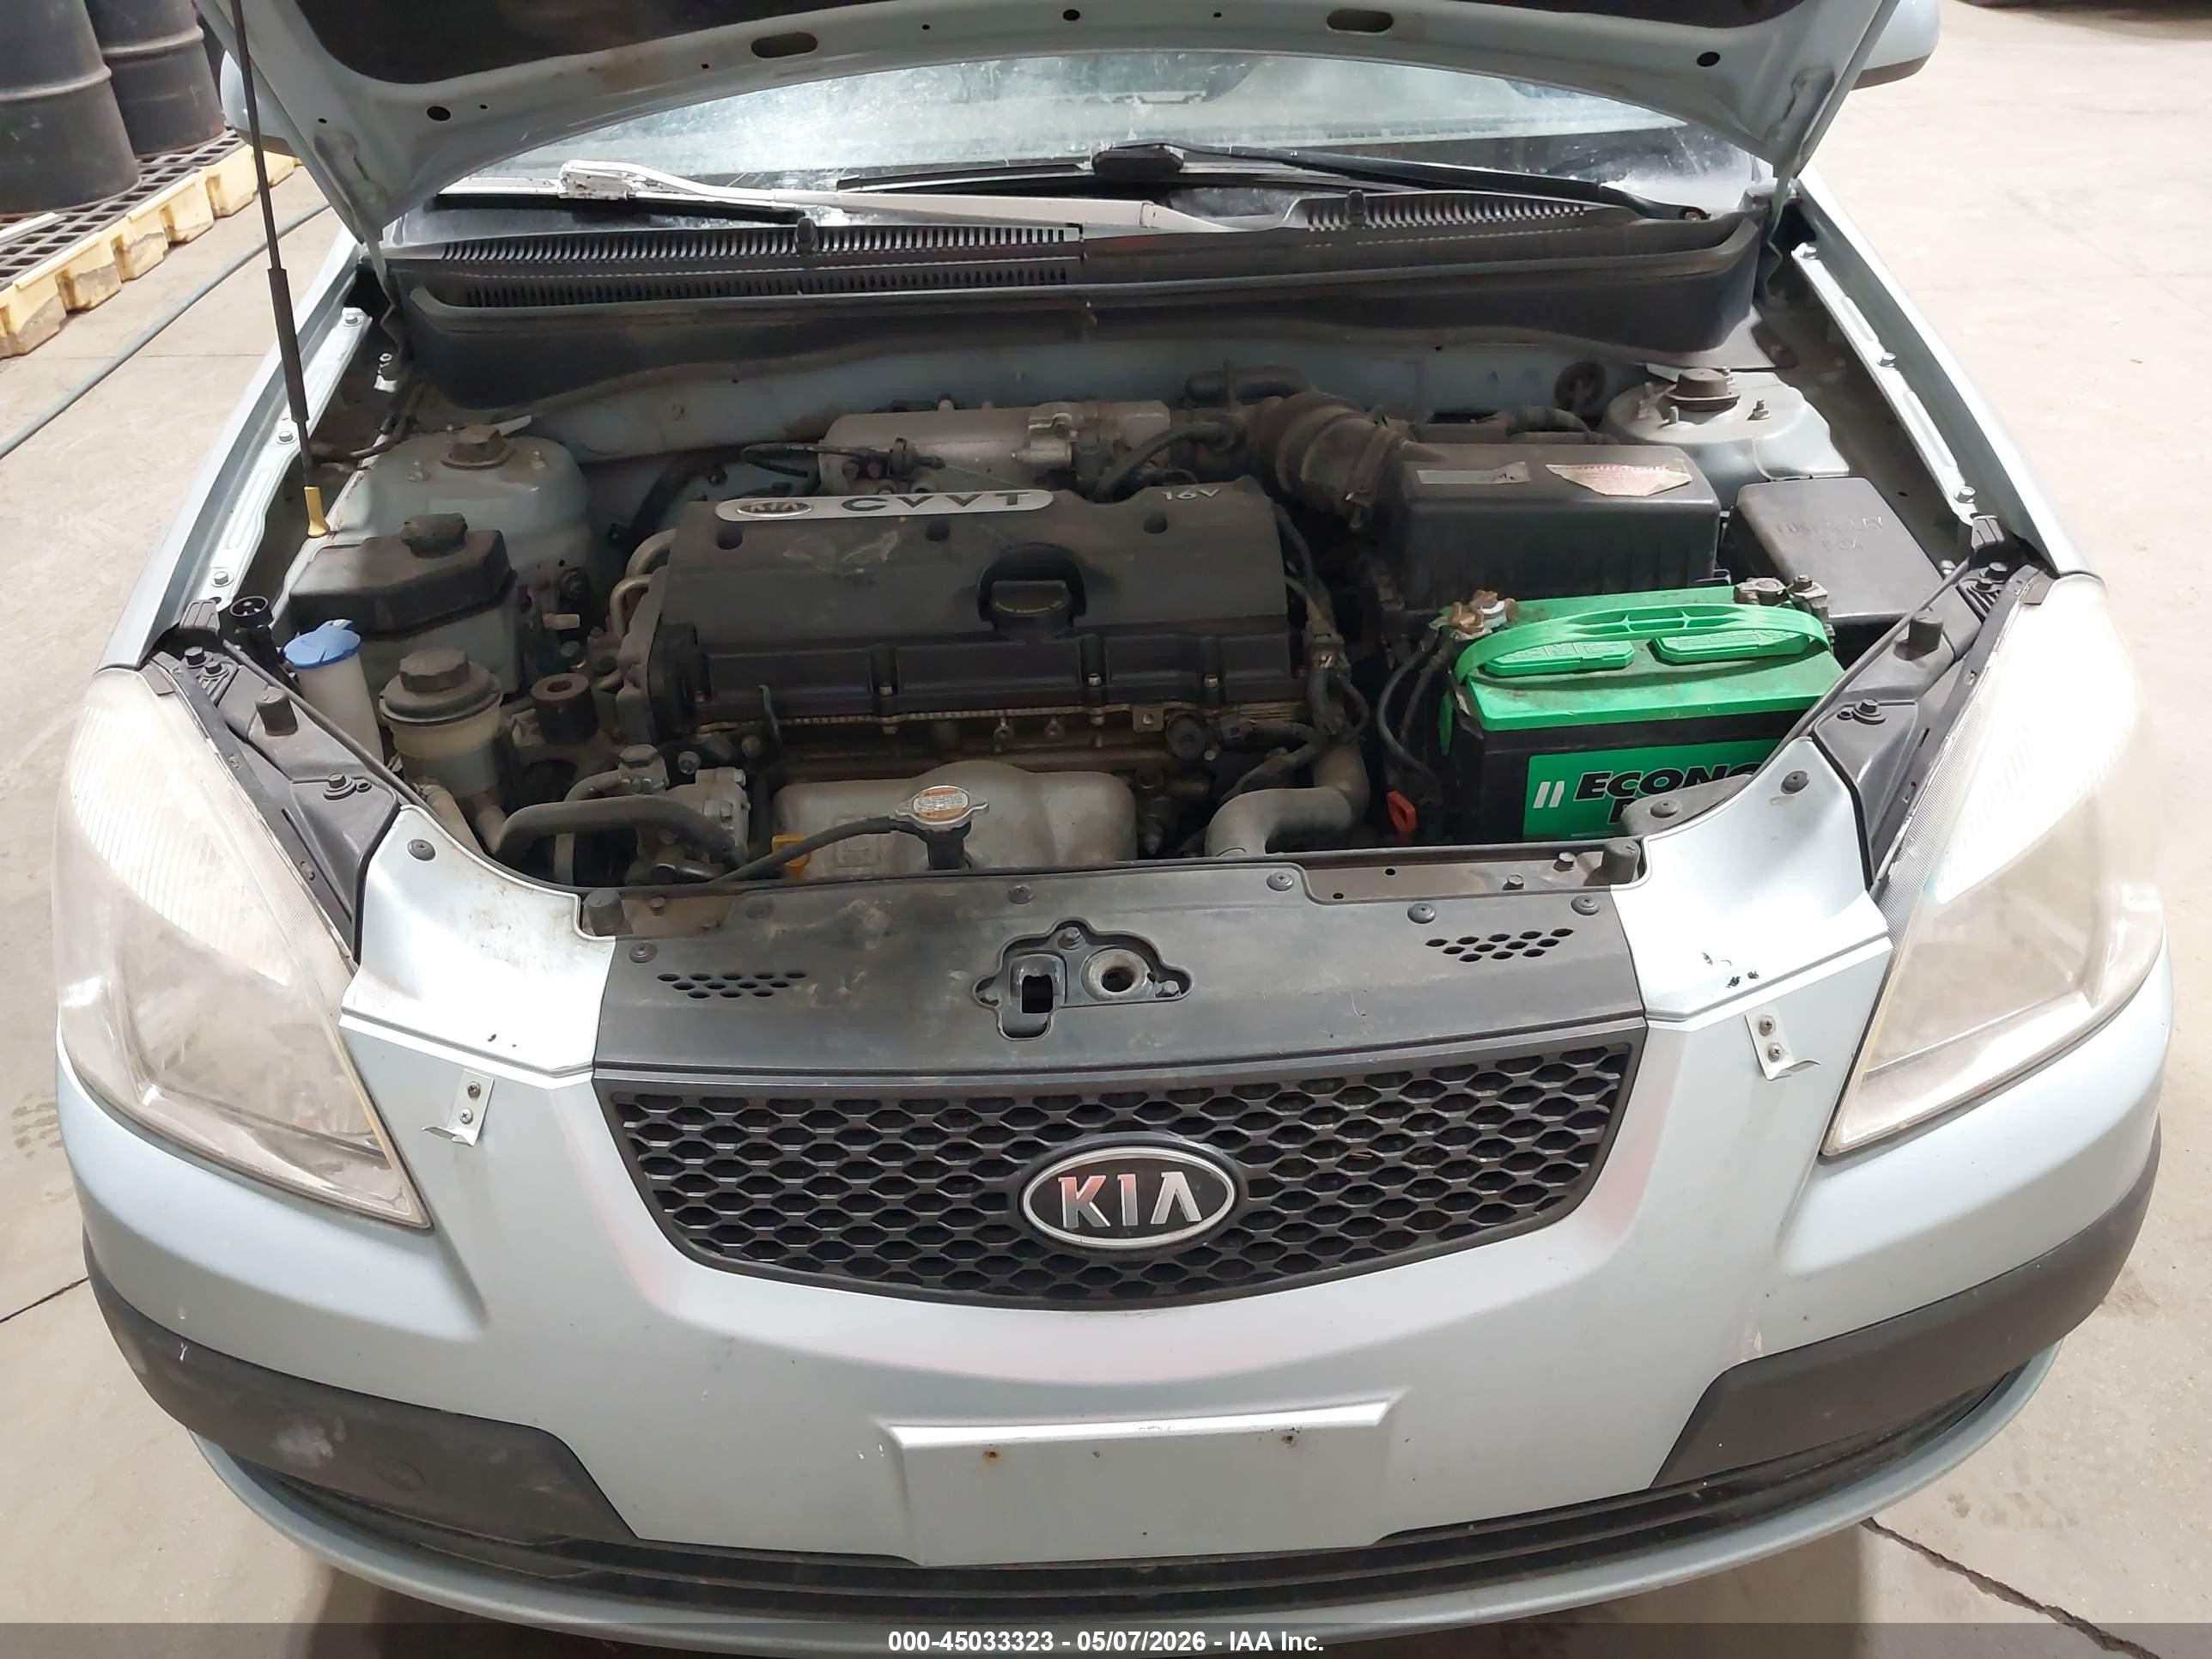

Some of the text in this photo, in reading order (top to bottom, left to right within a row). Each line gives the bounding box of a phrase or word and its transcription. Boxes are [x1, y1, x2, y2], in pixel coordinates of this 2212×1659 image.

[749, 491, 1030, 513] KIA CVVT
[1161, 488, 1221, 501] 16V
[1058, 1170, 1202, 1228] KIA
